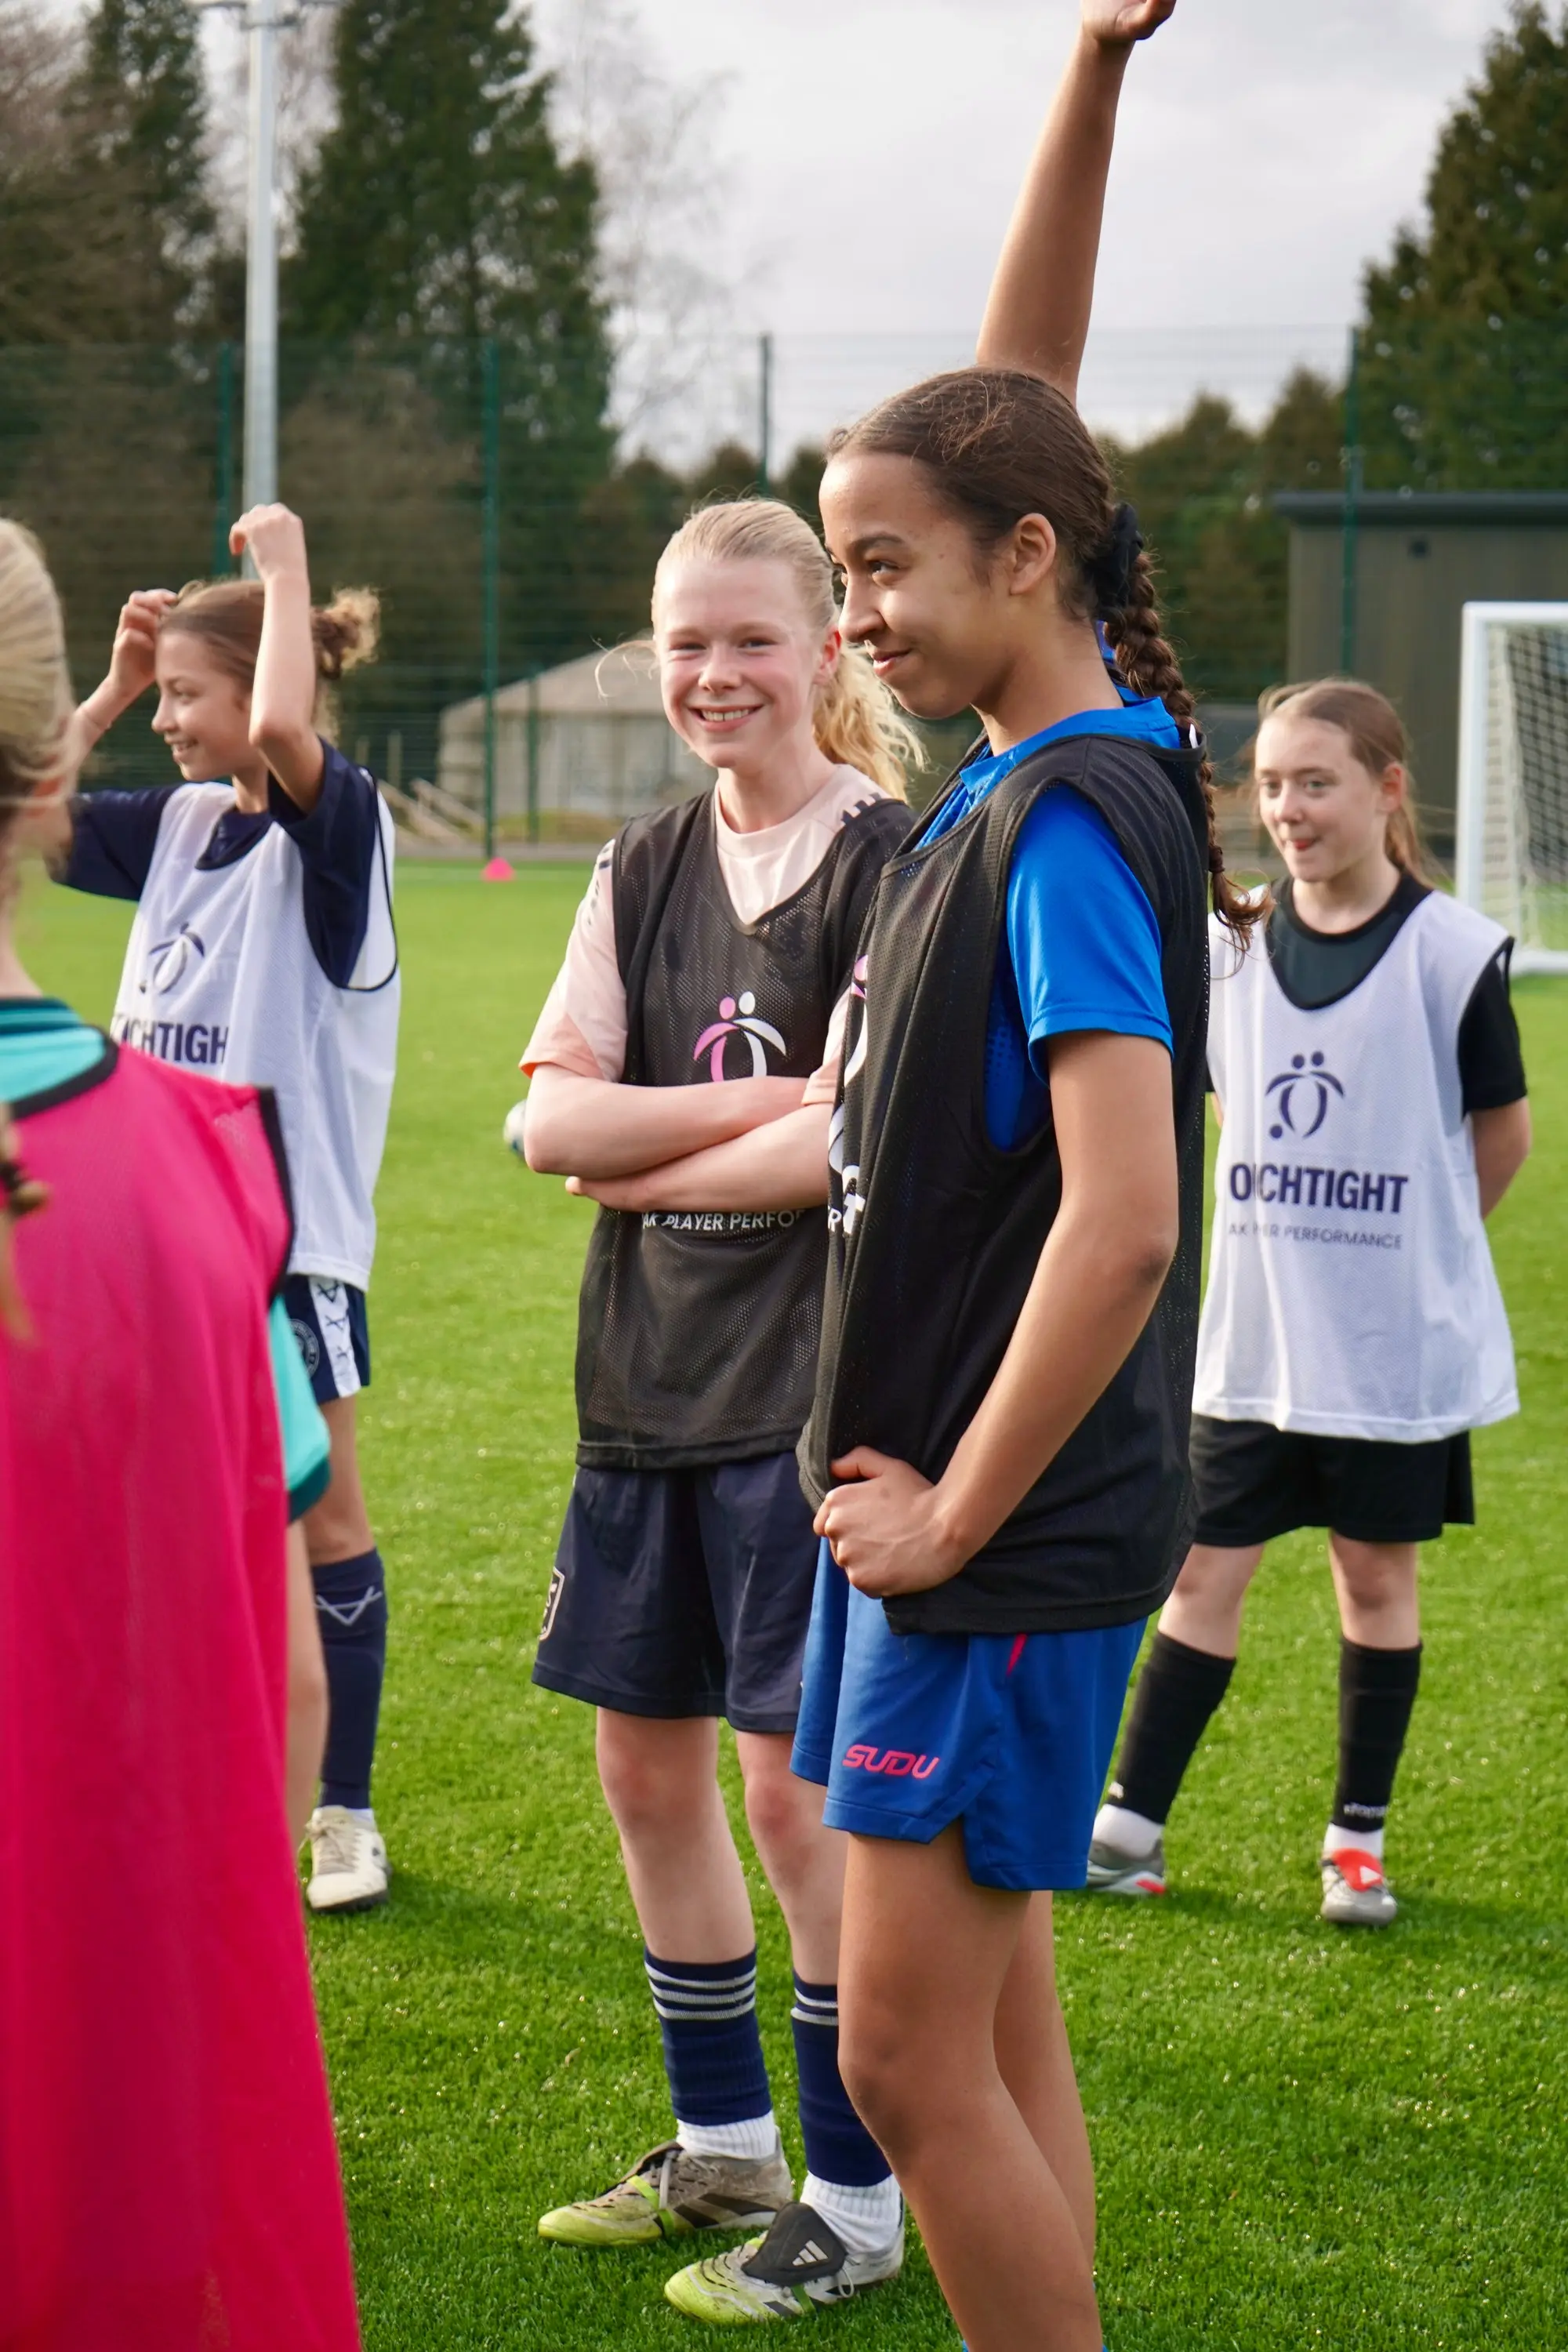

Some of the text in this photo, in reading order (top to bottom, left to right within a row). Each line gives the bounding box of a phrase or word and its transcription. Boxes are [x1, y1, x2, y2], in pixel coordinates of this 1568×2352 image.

[662, 1213, 723, 1231] PLAYER
[1283, 1224, 1403, 1250] PERFORMANCE
[841, 1744, 940, 1780] SUDU
